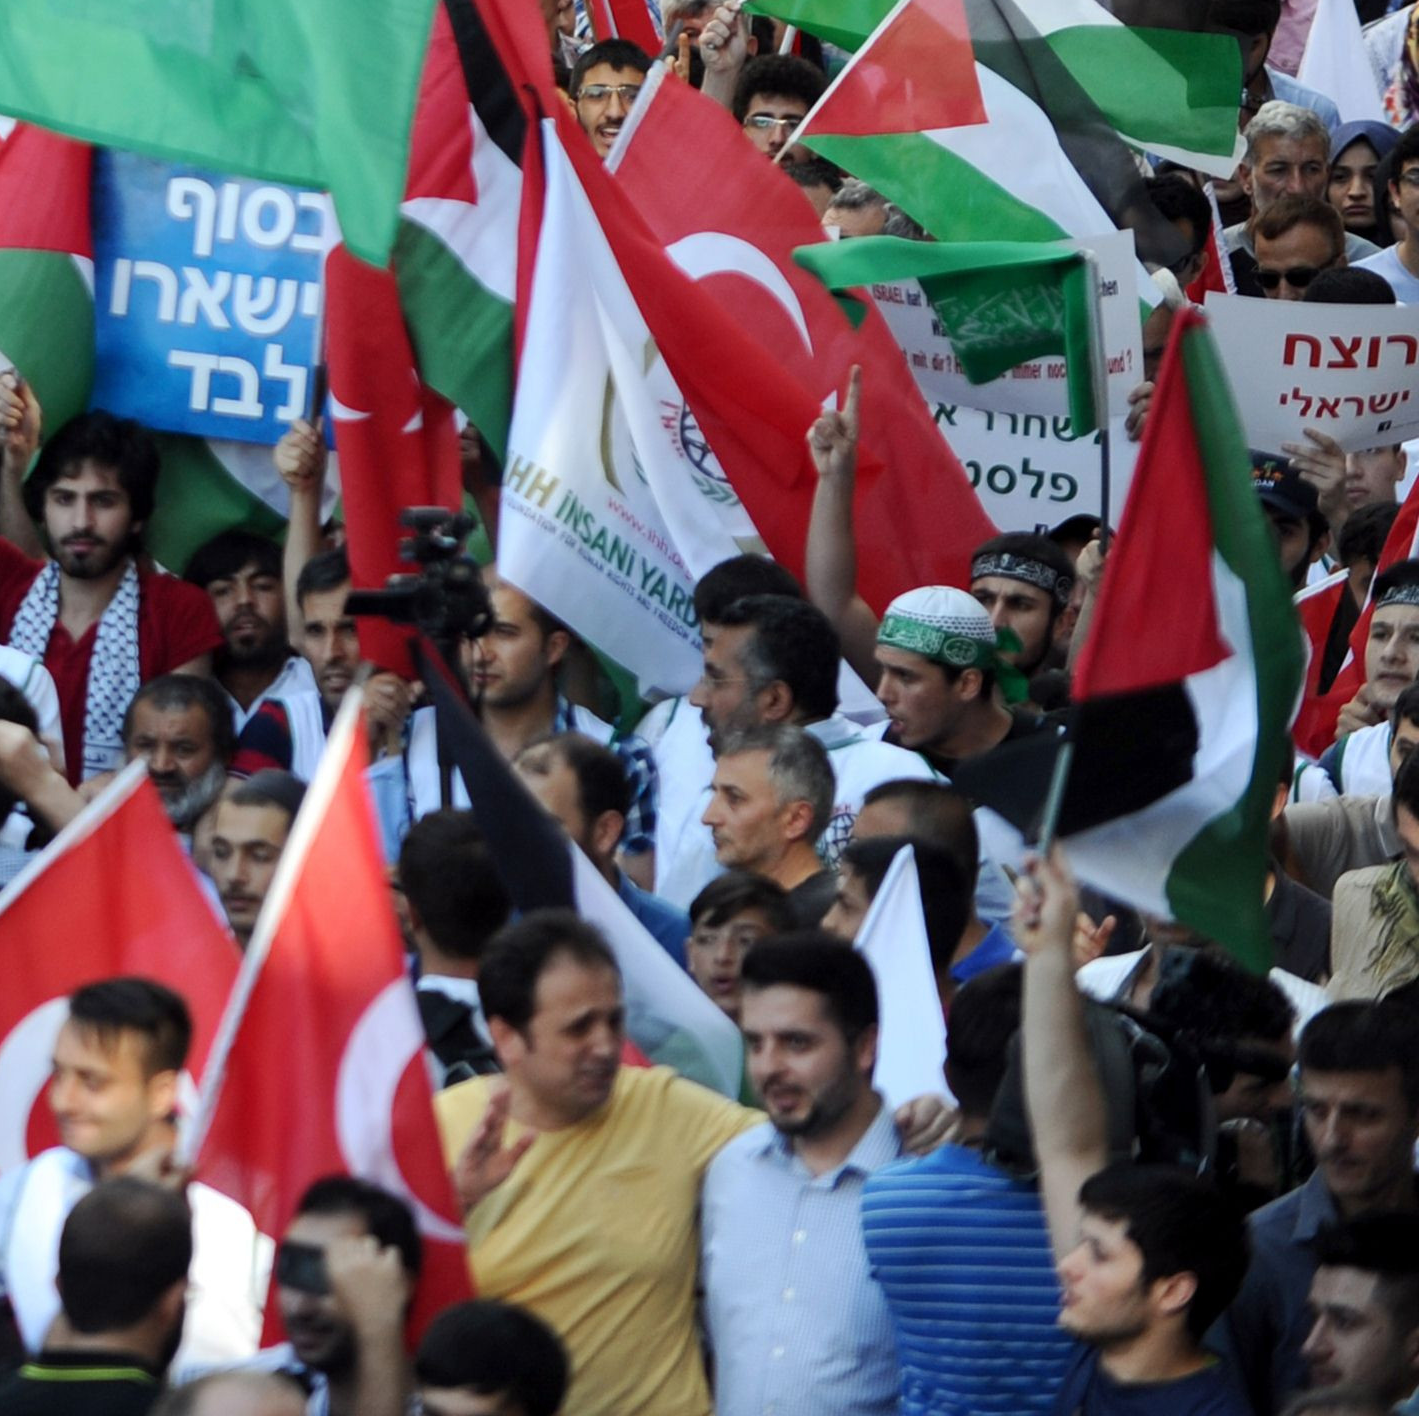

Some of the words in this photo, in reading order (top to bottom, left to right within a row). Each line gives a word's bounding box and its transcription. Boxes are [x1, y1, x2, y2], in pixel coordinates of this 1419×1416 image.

[109, 257, 321, 336] ישארו
[873, 283, 904, 303] ISRAEL
[1283, 333, 1419, 369] רוצח
[167, 343, 309, 422] לבד
[1279, 387, 1411, 419] ישראלי
[638, 556, 702, 629] YARD
